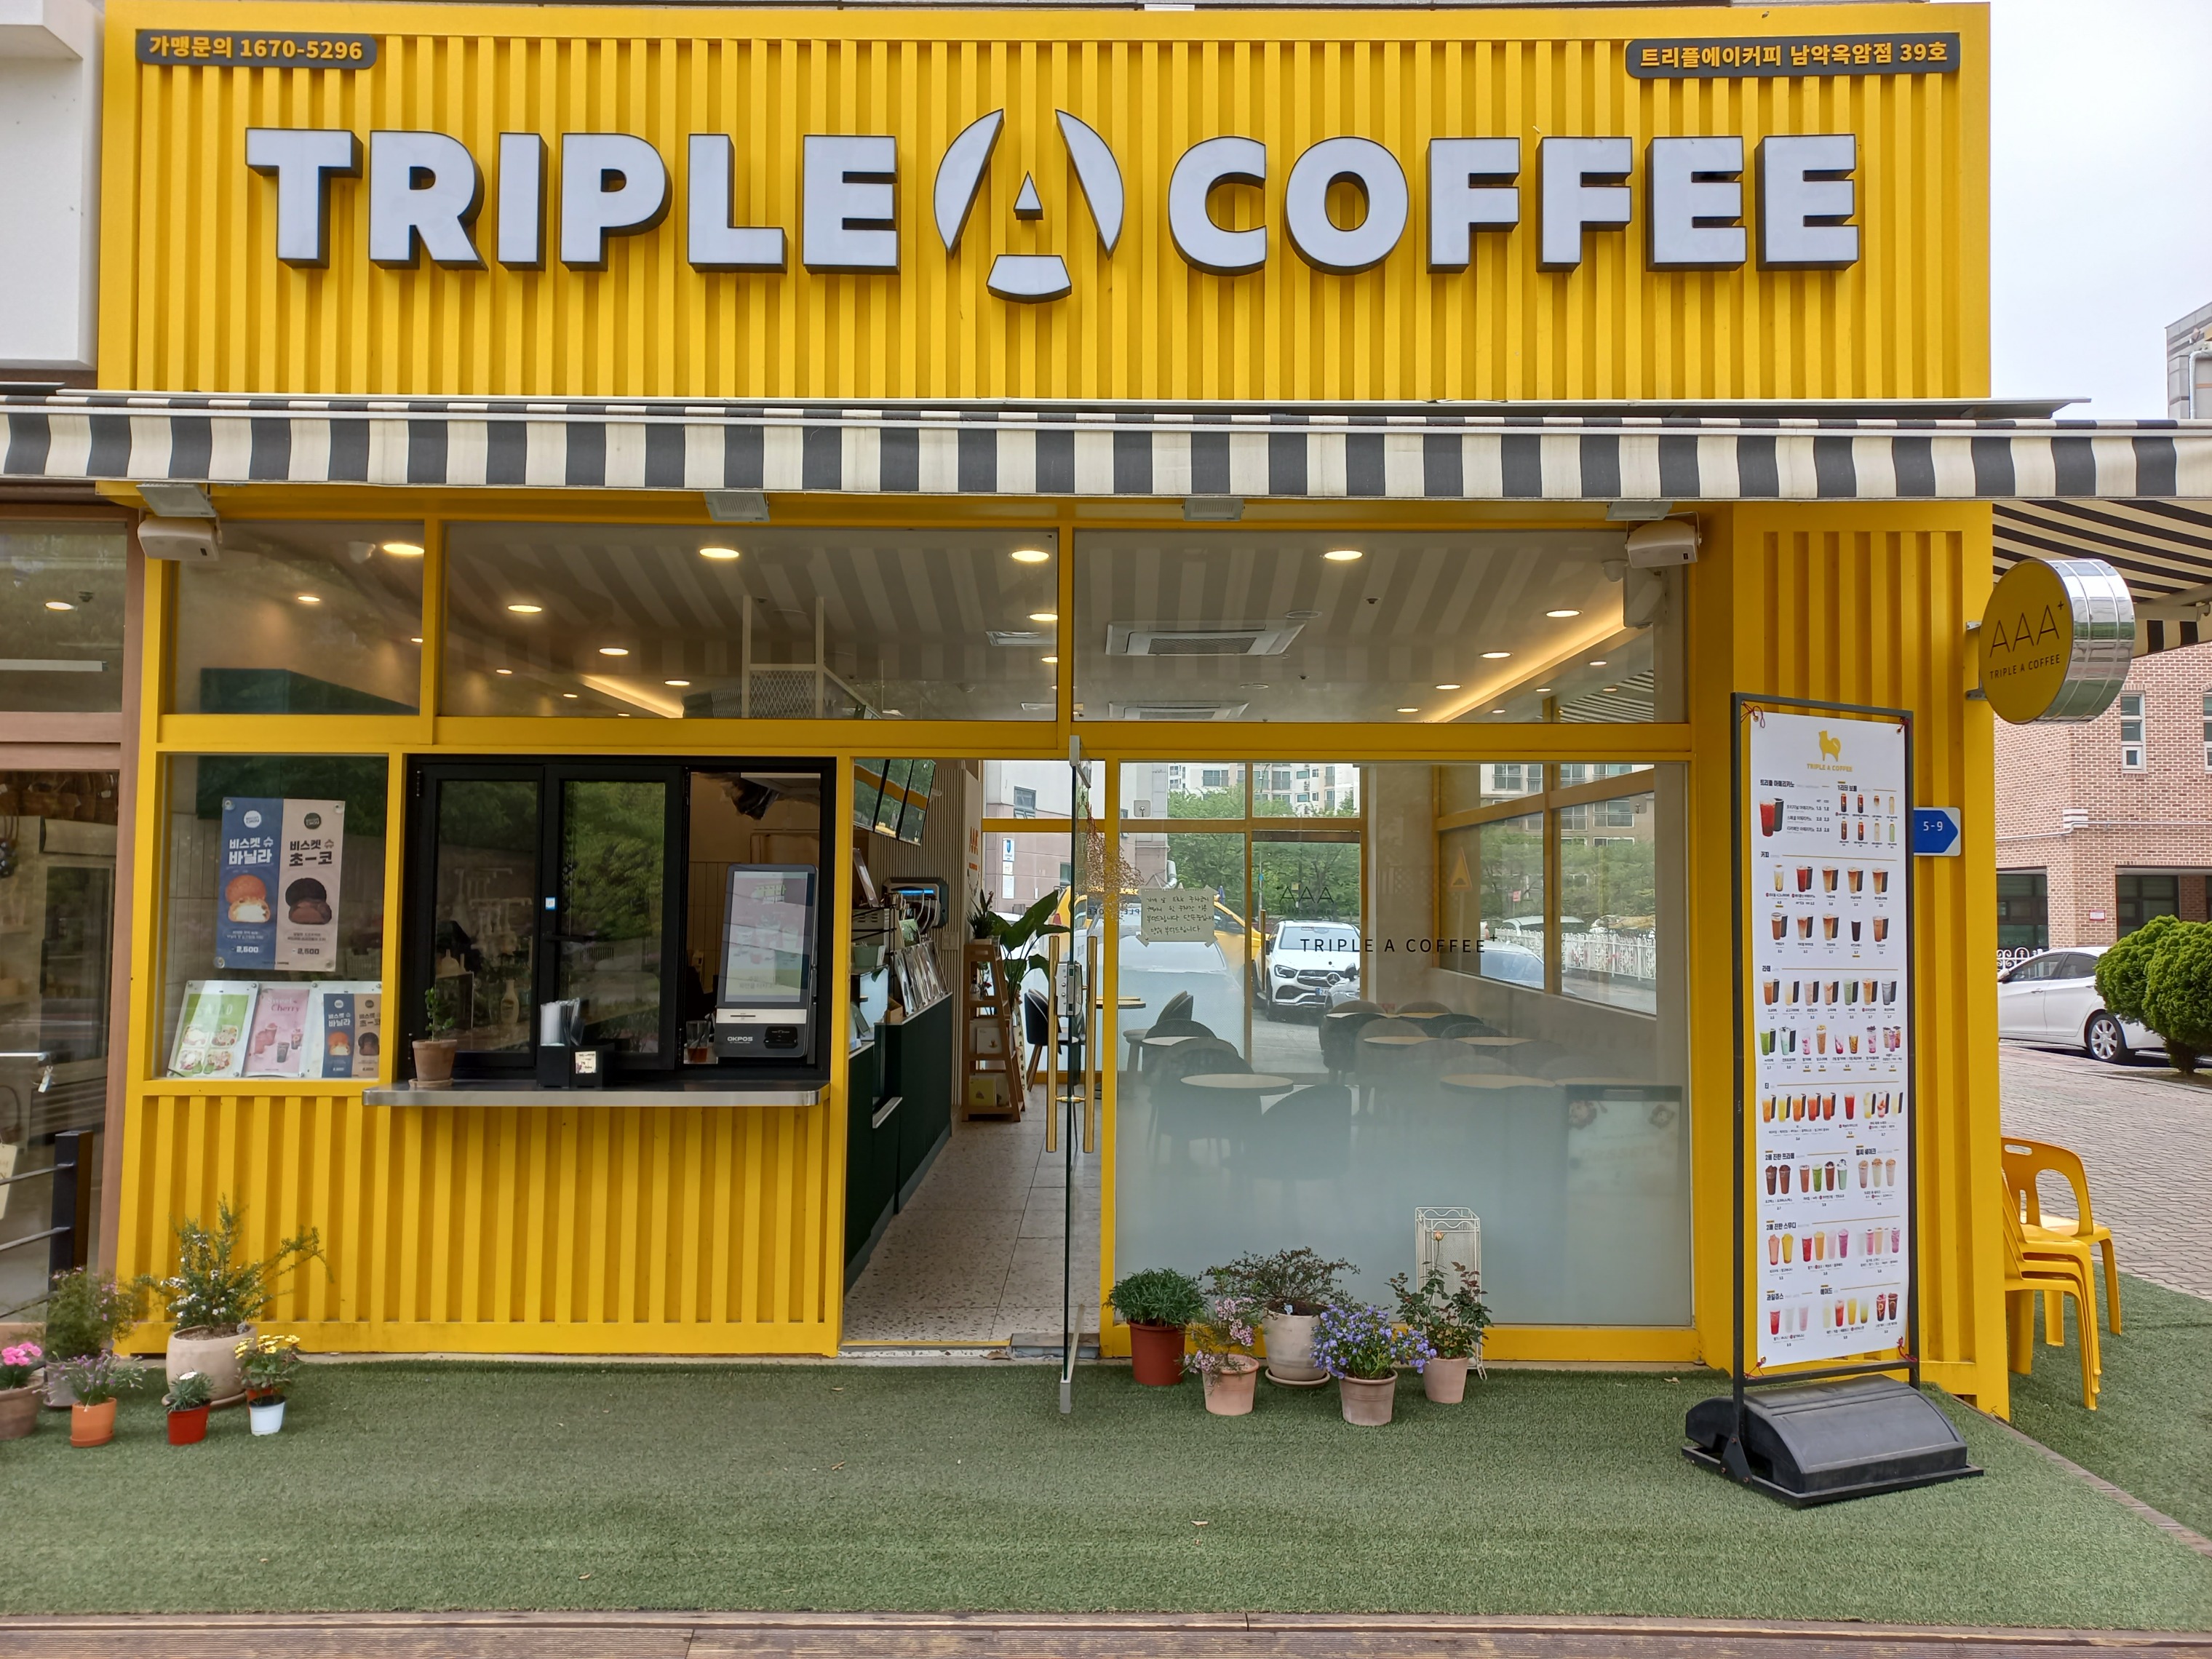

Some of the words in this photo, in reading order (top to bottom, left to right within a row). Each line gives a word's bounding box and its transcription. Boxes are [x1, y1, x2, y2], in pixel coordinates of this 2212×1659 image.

[149, 35, 232, 58] 가맹문의
[240, 39, 362, 60] 1670-5296
[1639, 44, 1782, 69] 트리플에이커피
[1790, 42, 1893, 67] 남악옥암점
[1899, 41, 1948, 62] 39호
[245, 127, 901, 275] TRIPLE
[1167, 134, 1861, 276] COFFEE
[1989, 664, 2018, 680] TRIPLE
[2020, 662, 2026, 673] A
[2028, 653, 2061, 671] COFFEE
[1773, 780, 1795, 788] 아메리카노
[1923, 821, 1944, 832] 5-9
[229, 837, 260, 850] 비스켓
[263, 836, 274, 847] 슈
[290, 839, 322, 851] 비스켓
[324, 839, 335, 848] 슈
[228, 849, 272, 866] 바닐라
[1300, 938, 1374, 952] TRIPLE
[1384, 938, 1396, 952] A
[271, 1003, 300, 1013] Cherry
[328, 1019, 351, 1027] 바닐라
[1783, 1222, 1797, 1230] 스무디
